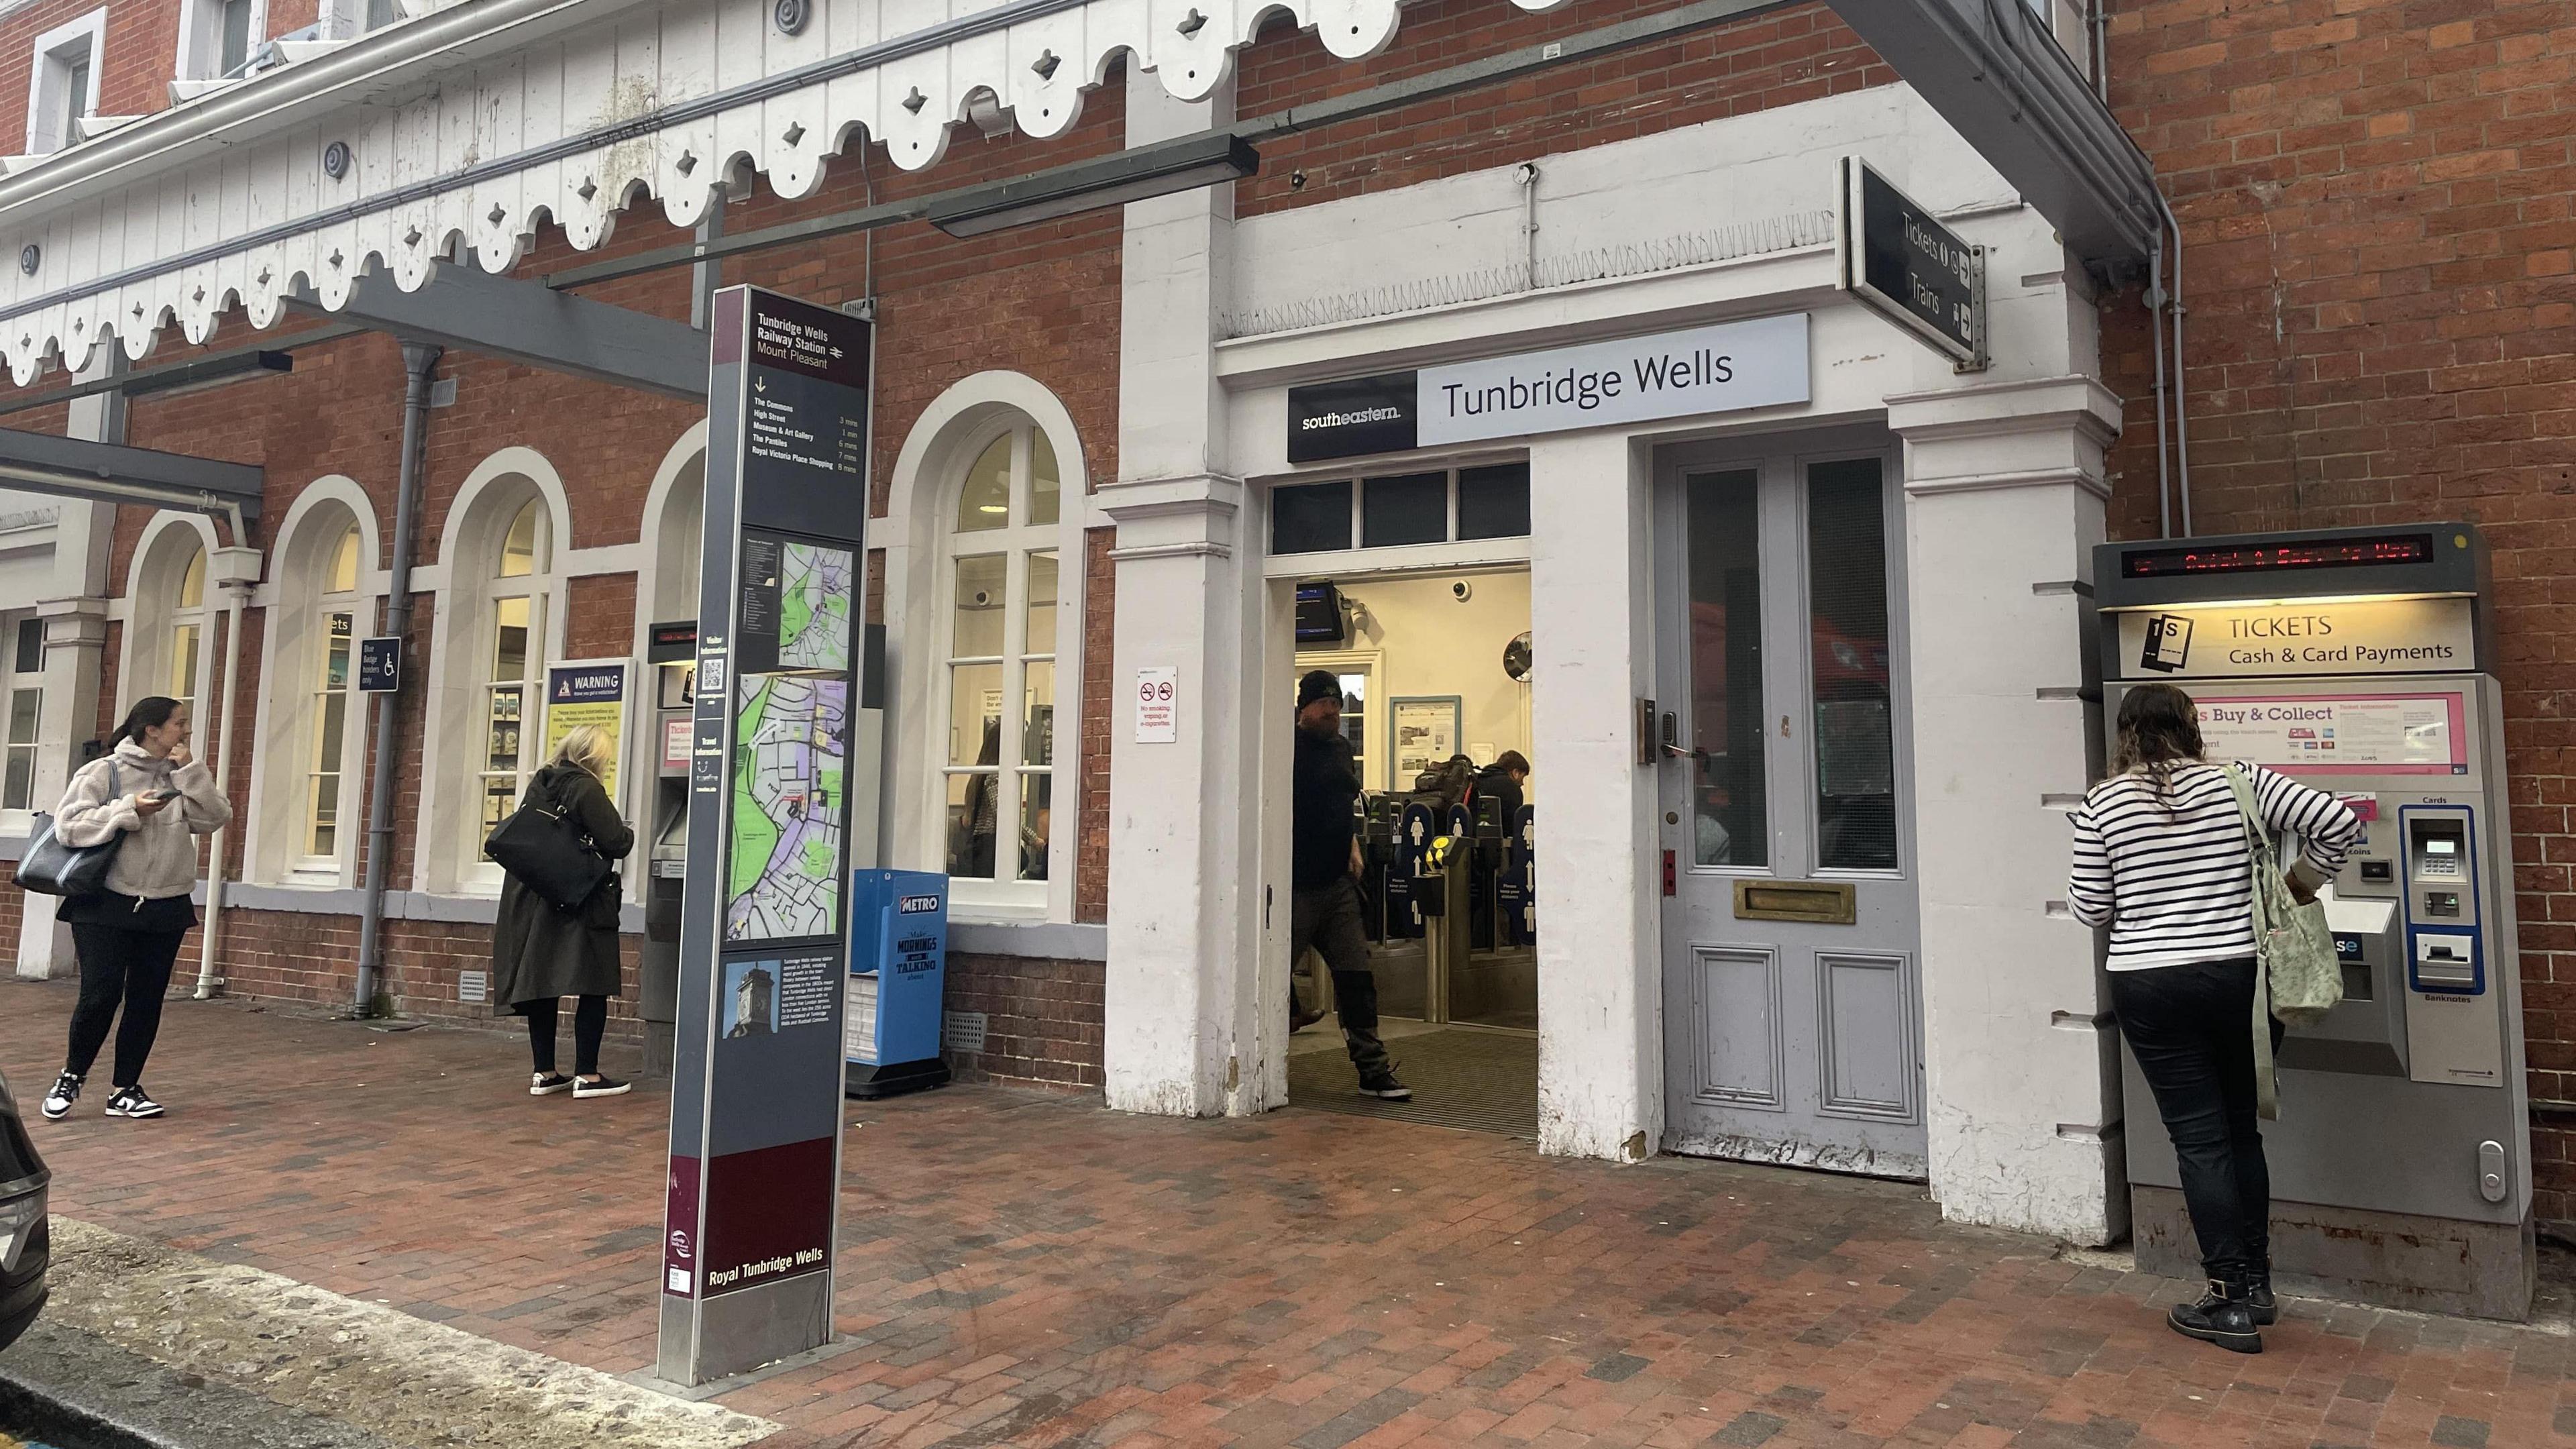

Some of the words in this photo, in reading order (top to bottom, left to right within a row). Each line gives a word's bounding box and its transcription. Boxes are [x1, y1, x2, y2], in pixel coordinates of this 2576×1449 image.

[1902, 211, 1937, 260] Tickets
[1911, 272, 1939, 315] Trains
[758, 313, 802, 335] Tunbridge
[805, 325, 828, 342] Wells
[758, 327, 792, 348] Railway
[796, 337, 826, 355] Station
[757, 341, 786, 359] Mount
[790, 350, 827, 369] Pleasant
[1442, 368, 1622, 417] Tunbridge
[1633, 349, 1733, 393] Wells
[754, 409, 767, 419] High
[768, 412, 786, 423] Street
[755, 397, 765, 407] The
[839, 416, 844, 424] 3
[845, 419, 858, 427] mins
[753, 421, 777, 433] Museum
[784, 428, 793, 437] Art
[794, 430, 814, 442] Gallery
[753, 433, 763, 443] The
[765, 436, 787, 447] Pantiles
[752, 445, 767, 456] Royal
[769, 449, 791, 460] Victoria
[792, 454, 808, 464] Place
[809, 457, 833, 470] Shopping
[838, 463, 843, 471] 8
[2227, 616, 2332, 638] TICKETS
[2229, 648, 2273, 663] Cash
[2282, 648, 2296, 662] &
[2303, 646, 2347, 662] Card
[2356, 644, 2453, 664] Payments
[575, 675, 619, 689] WARNING
[2212, 708, 2245, 724] Buy
[2251, 708, 2263, 720] &
[2268, 707, 2332, 720] Collect
[902, 897, 937, 912] METRO
[897, 937, 936, 953] MORNINGS
[2337, 941, 2358, 953] se
[896, 960, 936, 974] TALKING
[2424, 994, 2471, 1003] Banknotes
[709, 1266, 739, 1286] Royal
[742, 1256, 792, 1278] Tunbridge
[796, 1247, 823, 1265] Wells
